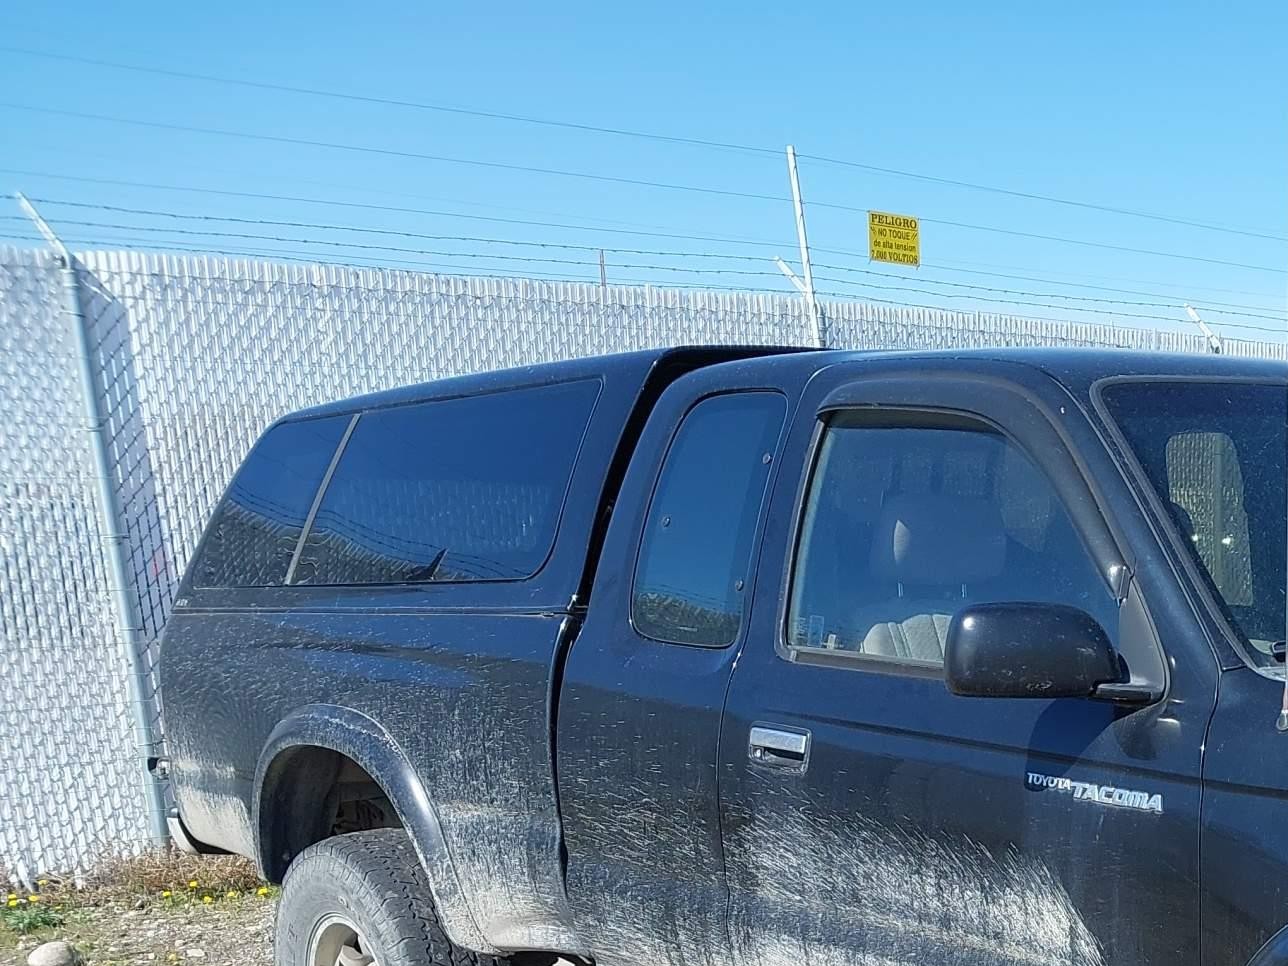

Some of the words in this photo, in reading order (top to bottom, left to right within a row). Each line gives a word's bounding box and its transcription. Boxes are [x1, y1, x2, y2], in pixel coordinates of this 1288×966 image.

[871, 213, 917, 229] PELIGRO
[878, 228, 887, 237] NO
[888, 251, 918, 264] VOLTIOS
[1027, 772, 1071, 791] TOYOTA
[1071, 781, 1164, 813] TACOMA
